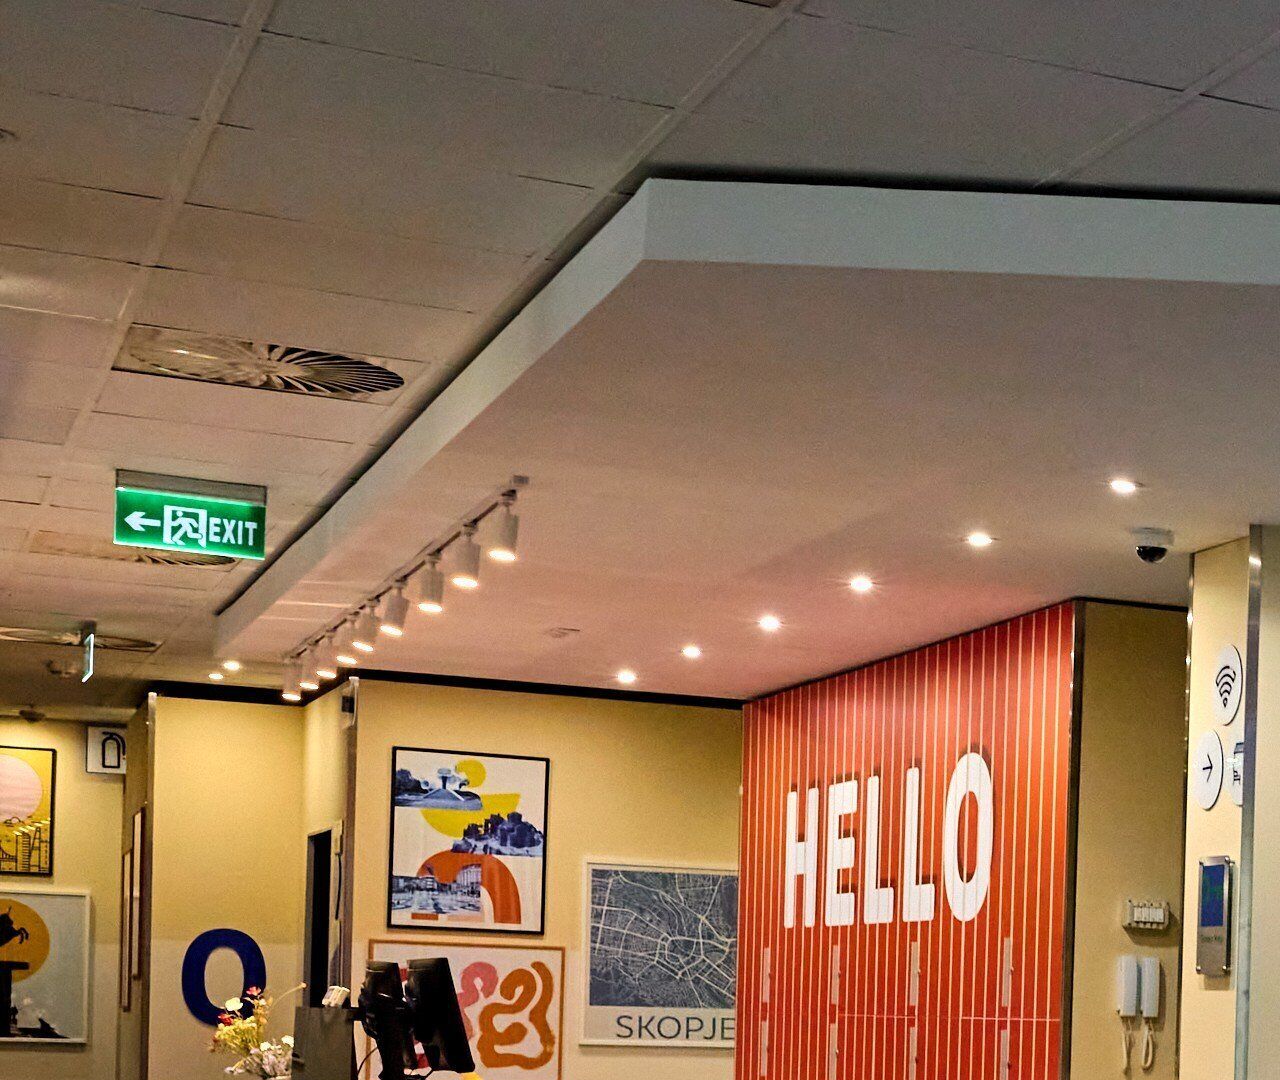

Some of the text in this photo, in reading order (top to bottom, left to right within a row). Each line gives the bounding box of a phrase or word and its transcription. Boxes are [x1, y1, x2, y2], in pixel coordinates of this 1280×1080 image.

[208, 516, 258, 546] EXIT
[783, 752, 994, 929] HELLO
[616, 1015, 735, 1041] SKOPJE
